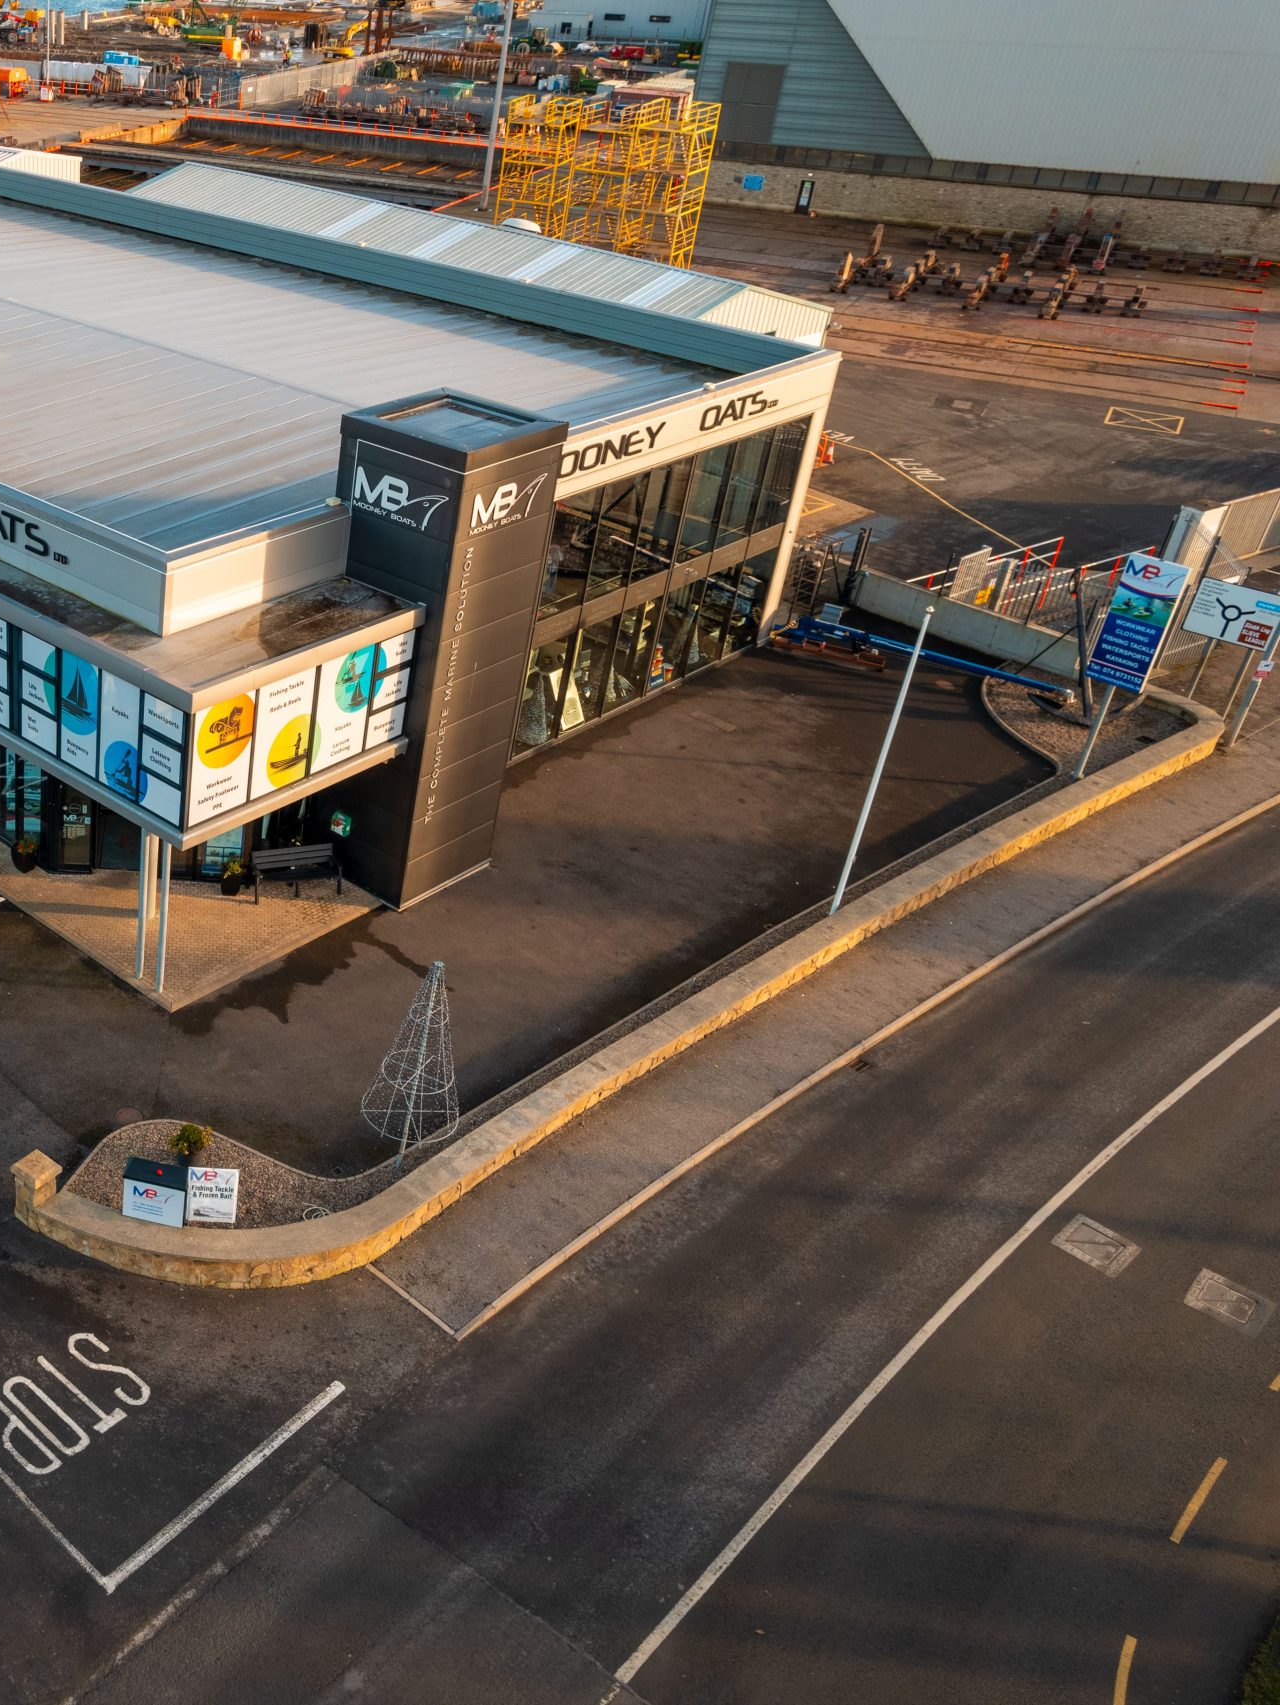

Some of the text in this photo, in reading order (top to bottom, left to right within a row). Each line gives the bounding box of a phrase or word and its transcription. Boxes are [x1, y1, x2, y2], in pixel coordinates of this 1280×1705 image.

[558, 421, 667, 479] OONEY
[699, 390, 767, 432] OATS
[354, 466, 409, 512] MB
[470, 482, 518, 528] MB
[352, 500, 417, 528] MOONEY BOATS
[469, 514, 522, 536] MOONEY BOATS
[1125, 559, 1161, 579] MB
[1115, 619, 1157, 635] WORKWEAR
[1242, 629, 1260, 638] SLIEVE
[1115, 628, 1149, 643] CLOTHING
[1245, 636, 1266, 646] LEAGUE
[1102, 634, 1156, 654] FISHING TACKLE
[1101, 643, 1150, 662] WATERSPORTS
[1105, 654, 1139, 668] KAYAKING
[28, 682, 37, 691] Life
[269, 680, 305, 698] Fishing Tackle
[385, 687, 402, 698] Jackets
[424, 547, 474, 825] THE COMPLETE MARINE SOLUTION
[28, 690, 44, 703] Jackets
[111, 705, 129, 720] Kayaks
[270, 696, 302, 714] Rods & Reels
[148, 708, 180, 730] Watersports
[335, 721, 352, 732] Kayaks
[373, 718, 396, 733] Buoyancy
[27, 723, 39, 733] Suits
[66, 739, 89, 756] Buoyancy
[332, 737, 350, 749] Leisure
[67, 747, 77, 757] Aids
[151, 748, 171, 762] Leisure
[330, 744, 351, 758] Clothing
[150, 755, 172, 772] Clothing
[206, 775, 232, 790] Workwear
[197, 784, 239, 806] Safety Footwear
[212, 802, 223, 811] PPE
[190, 1168, 218, 1181] MB
[133, 1185, 157, 1199] MB
[215, 1185, 234, 1193] Tackle
